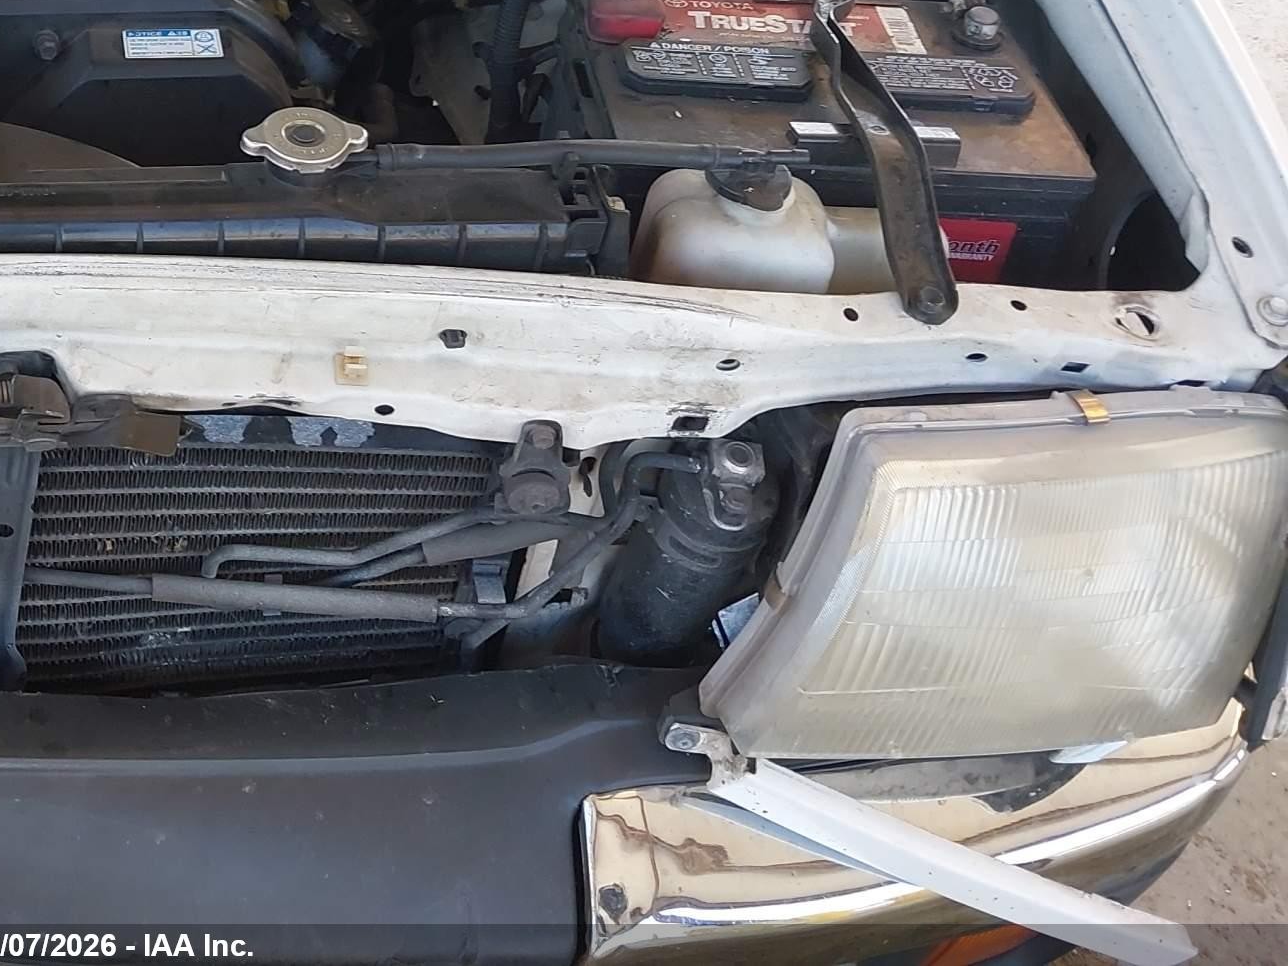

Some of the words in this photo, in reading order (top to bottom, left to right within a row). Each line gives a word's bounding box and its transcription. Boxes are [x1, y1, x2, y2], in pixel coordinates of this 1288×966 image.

[688, 0, 754, 11] TOYOTA
[660, 42, 712, 52] DANGER
[723, 46, 770, 55] POISON
[948, 239, 1001, 254] onth
